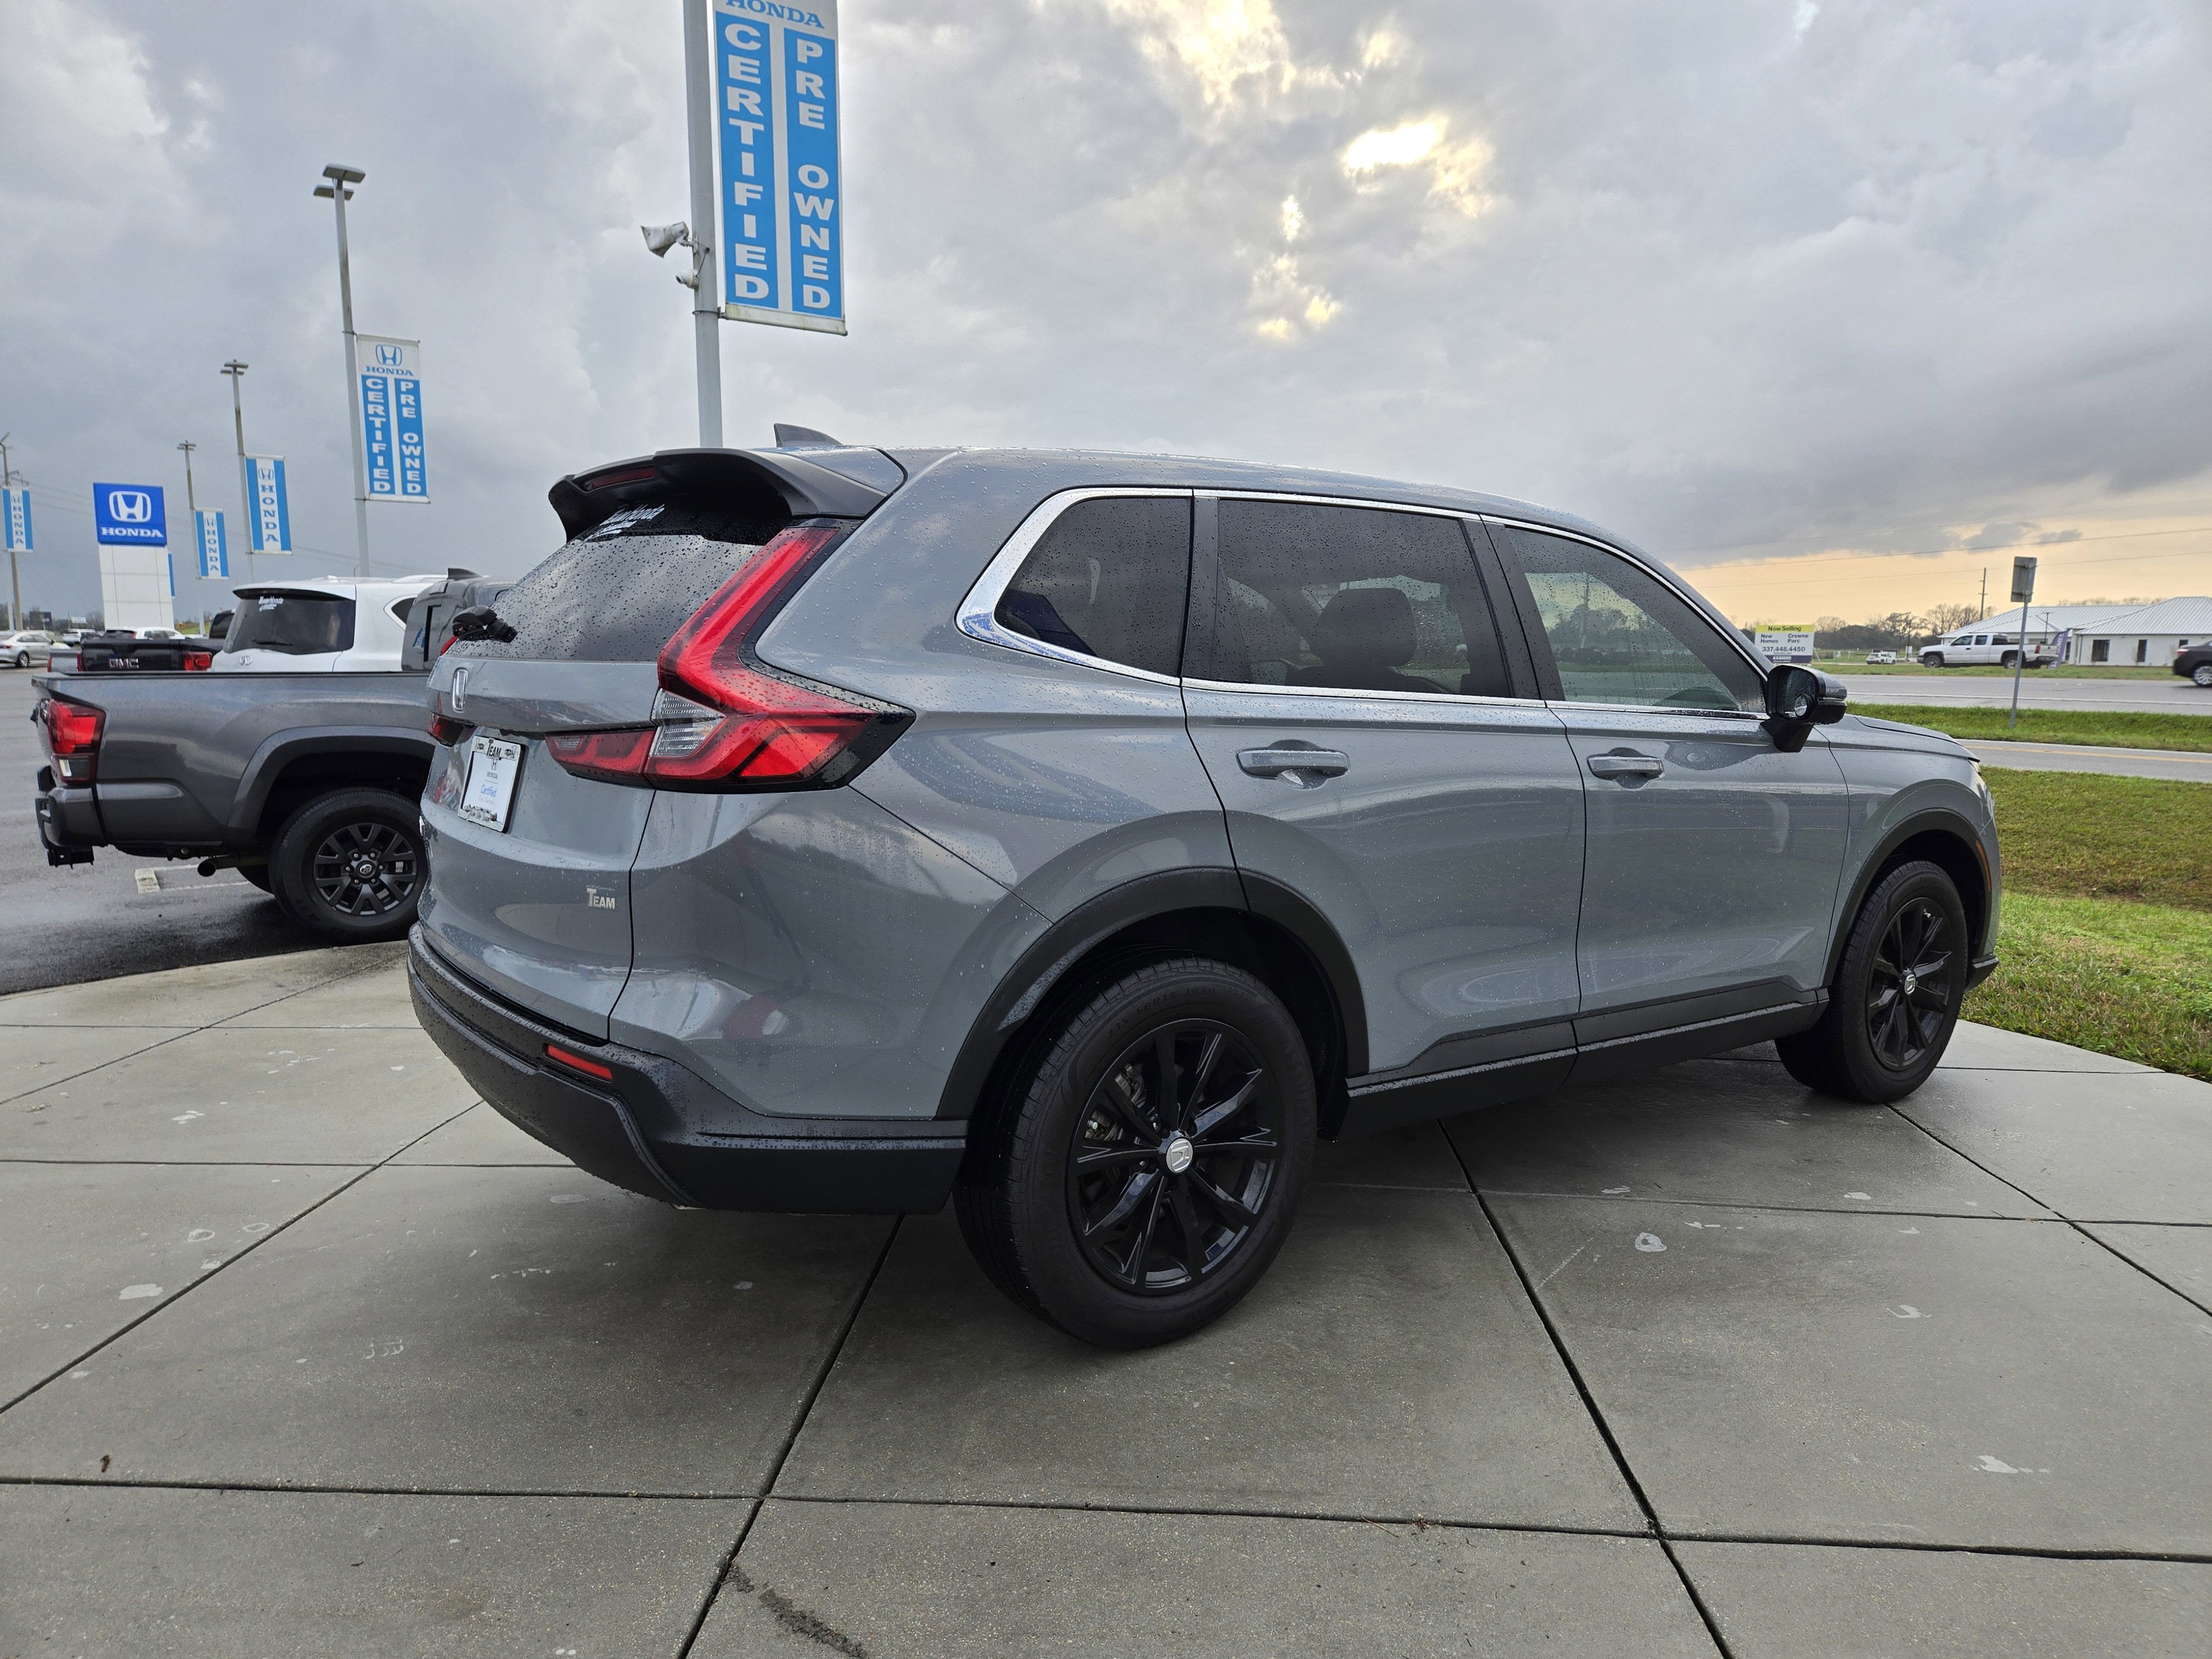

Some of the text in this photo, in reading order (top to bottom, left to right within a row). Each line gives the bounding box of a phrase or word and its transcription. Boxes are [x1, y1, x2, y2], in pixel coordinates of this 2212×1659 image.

[726, 0, 825, 29] HONDA
[724, 23, 769, 299] CERTIFIED
[794, 38, 834, 309] PRE OWNED
[366, 366, 414, 377] HONDA
[366, 378, 391, 492] CERTIFIED
[400, 381, 422, 493] PRE OWNED
[13, 505, 24, 544] HONDA
[101, 527, 164, 538] HONDA
[261, 484, 279, 542] HONDA
[206, 530, 219, 571] HONDA
[108, 658, 139, 669] GMC
[481, 784, 497, 797] Certified
